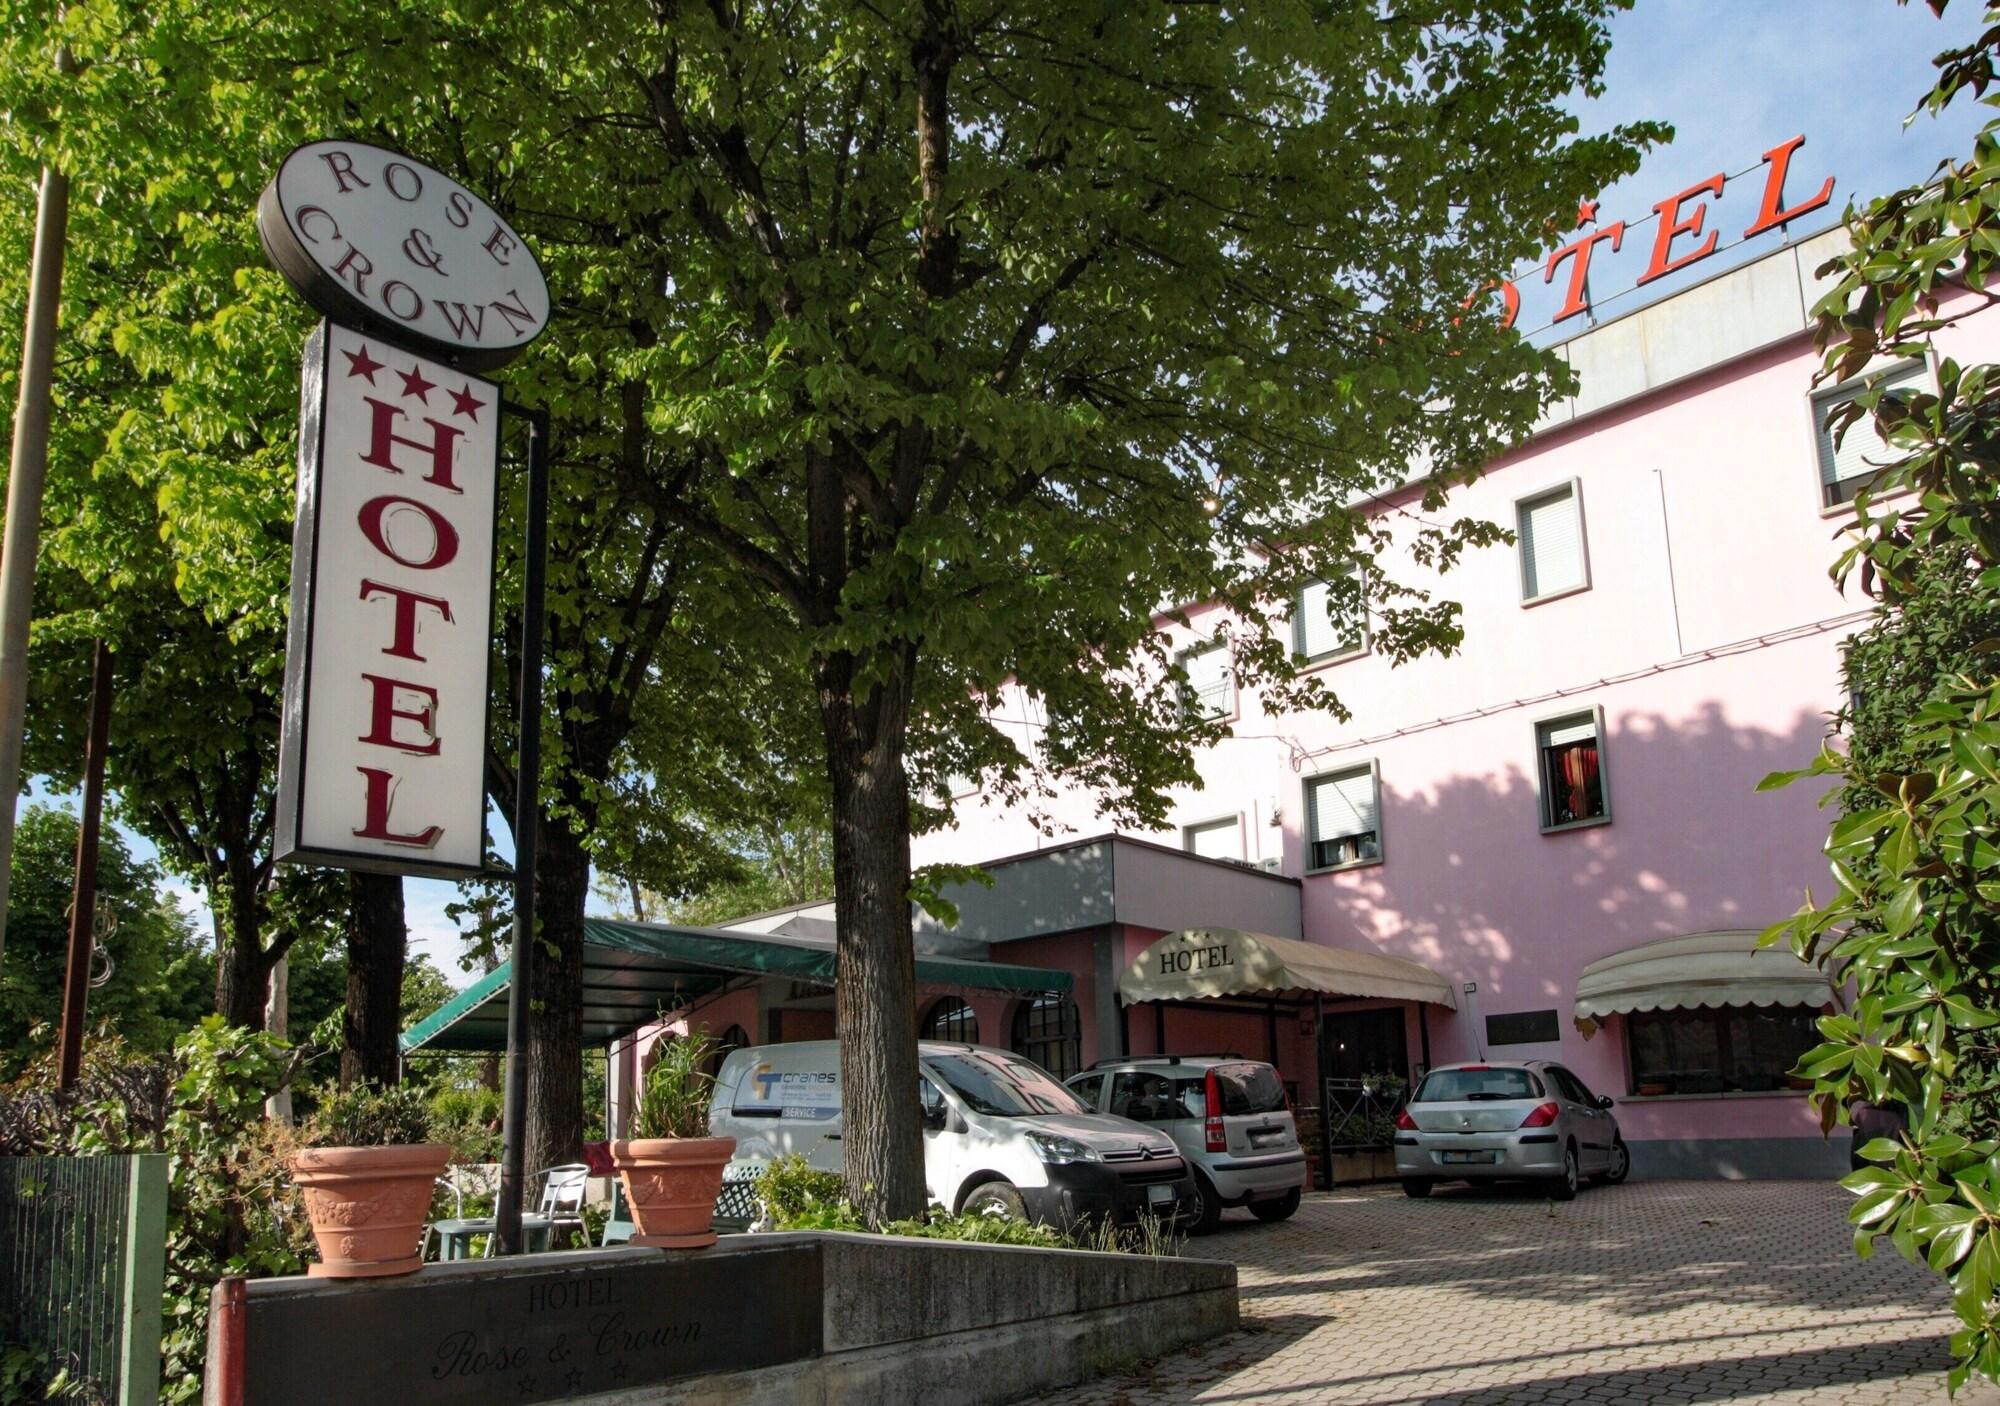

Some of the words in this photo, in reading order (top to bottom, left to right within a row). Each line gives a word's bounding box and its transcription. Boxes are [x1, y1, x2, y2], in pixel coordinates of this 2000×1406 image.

[318, 151, 518, 267] ROSE
[295, 203, 537, 342] CROWN
[402, 227, 449, 277] &
[1410, 133, 1836, 358] OTEL
[352, 395, 466, 849] HOTEL
[1160, 944, 1234, 974] HOTEL
[783, 1072, 837, 1084] cranes
[784, 1107, 817, 1119] SERVICE
[528, 1276, 622, 1313] HOTEL
[431, 1329, 529, 1380] Rose
[548, 1333, 572, 1364] &
[587, 1311, 702, 1356] Crown
